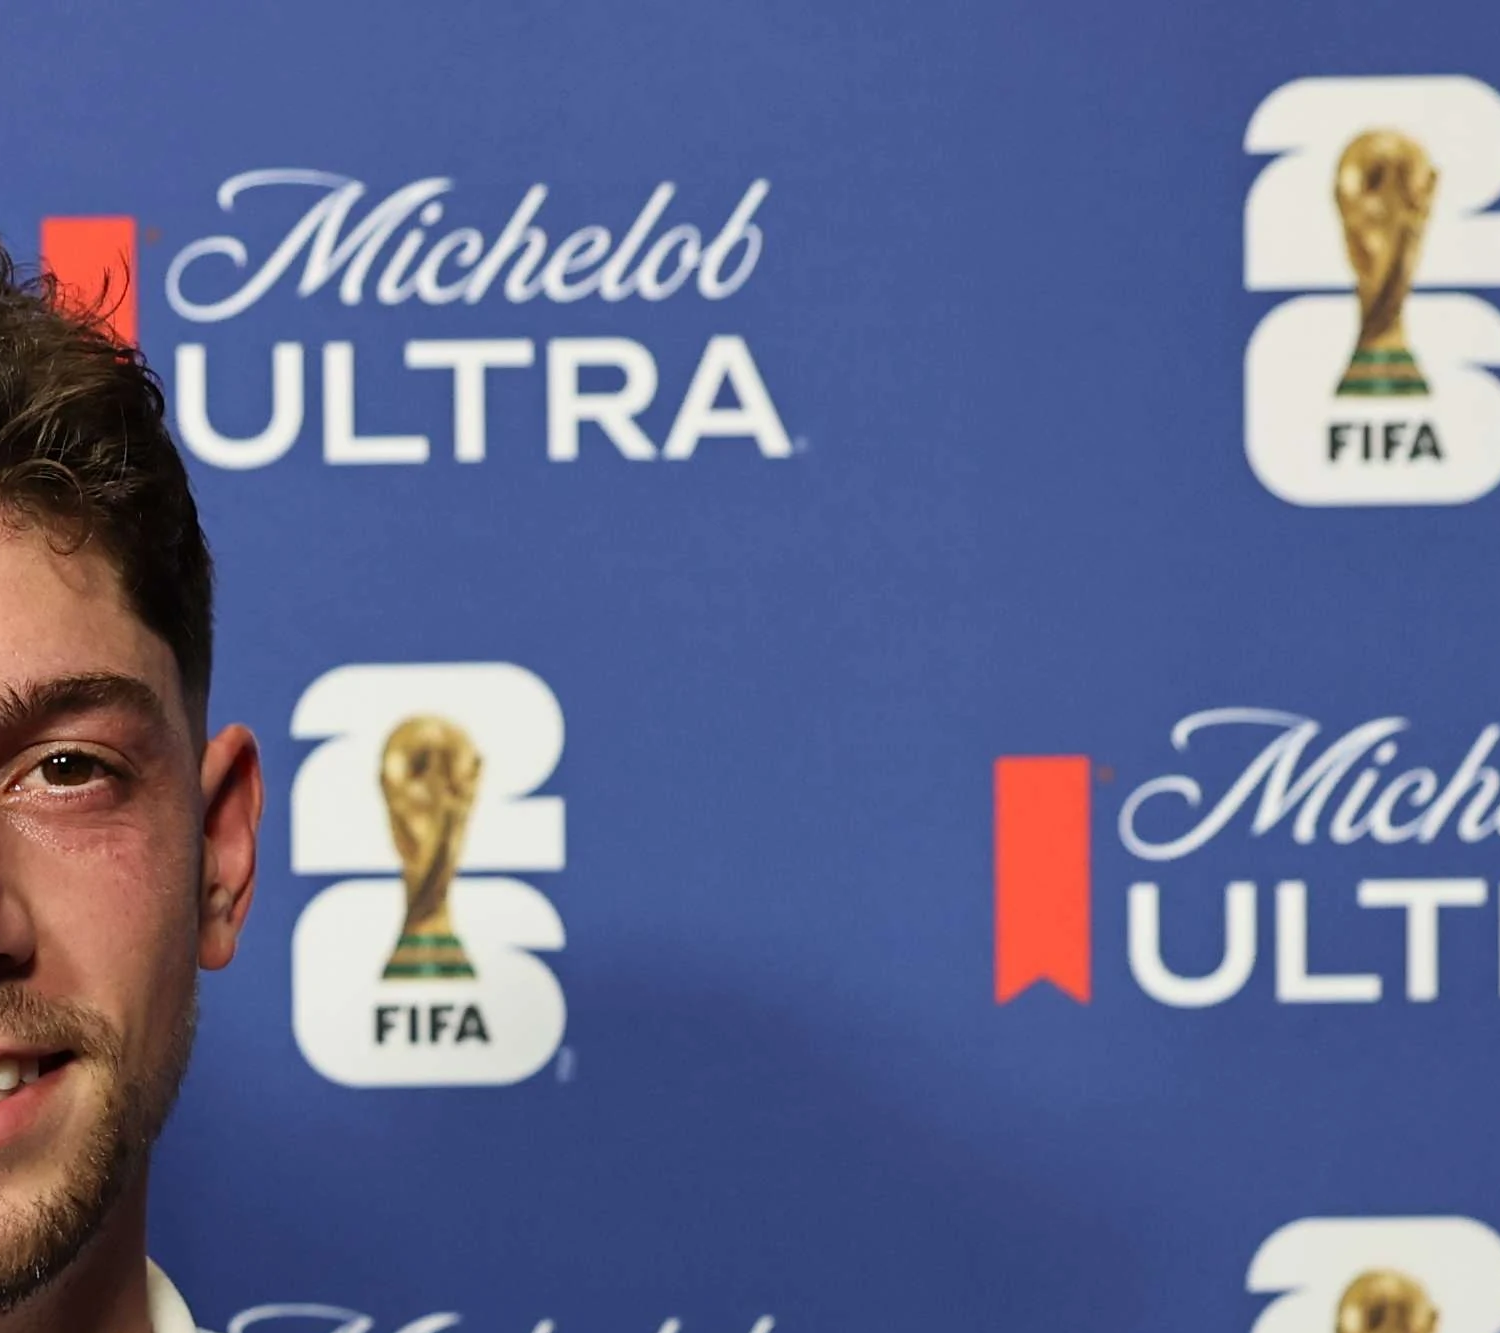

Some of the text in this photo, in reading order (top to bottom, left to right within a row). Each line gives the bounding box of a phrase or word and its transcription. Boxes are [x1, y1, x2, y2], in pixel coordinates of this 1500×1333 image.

[166, 168, 769, 322] Michelob
[175, 335, 793, 469] ULTRA
[1328, 423, 1442, 462] FIFA
[376, 1005, 490, 1044] FIFA
